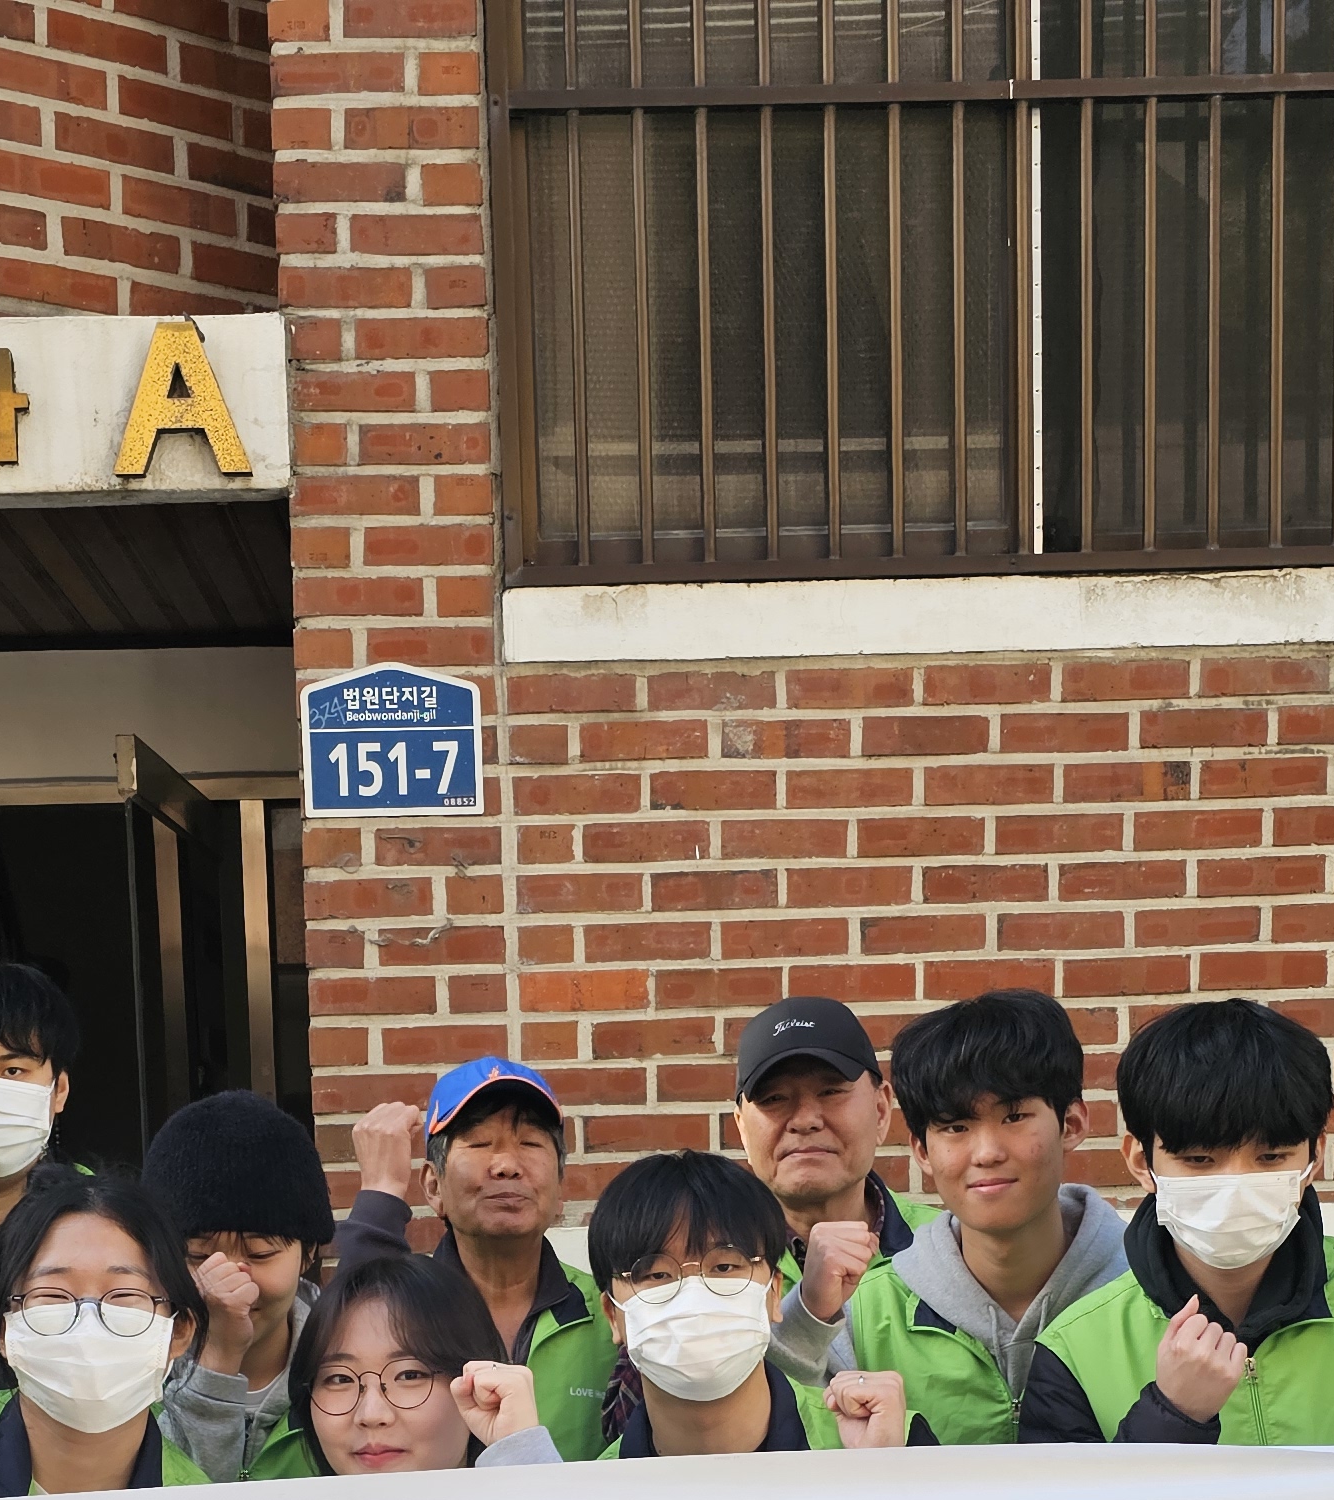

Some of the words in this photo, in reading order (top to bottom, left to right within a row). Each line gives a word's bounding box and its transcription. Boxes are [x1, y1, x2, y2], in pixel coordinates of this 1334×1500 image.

[113, 318, 253, 477] A
[343, 685, 437, 710] 법원단지길
[346, 709, 437, 723] Beobwondanji-gil
[328, 740, 459, 797] 151-7
[443, 797, 475, 806] 08852
[569, 1386, 594, 1398] LOVE
